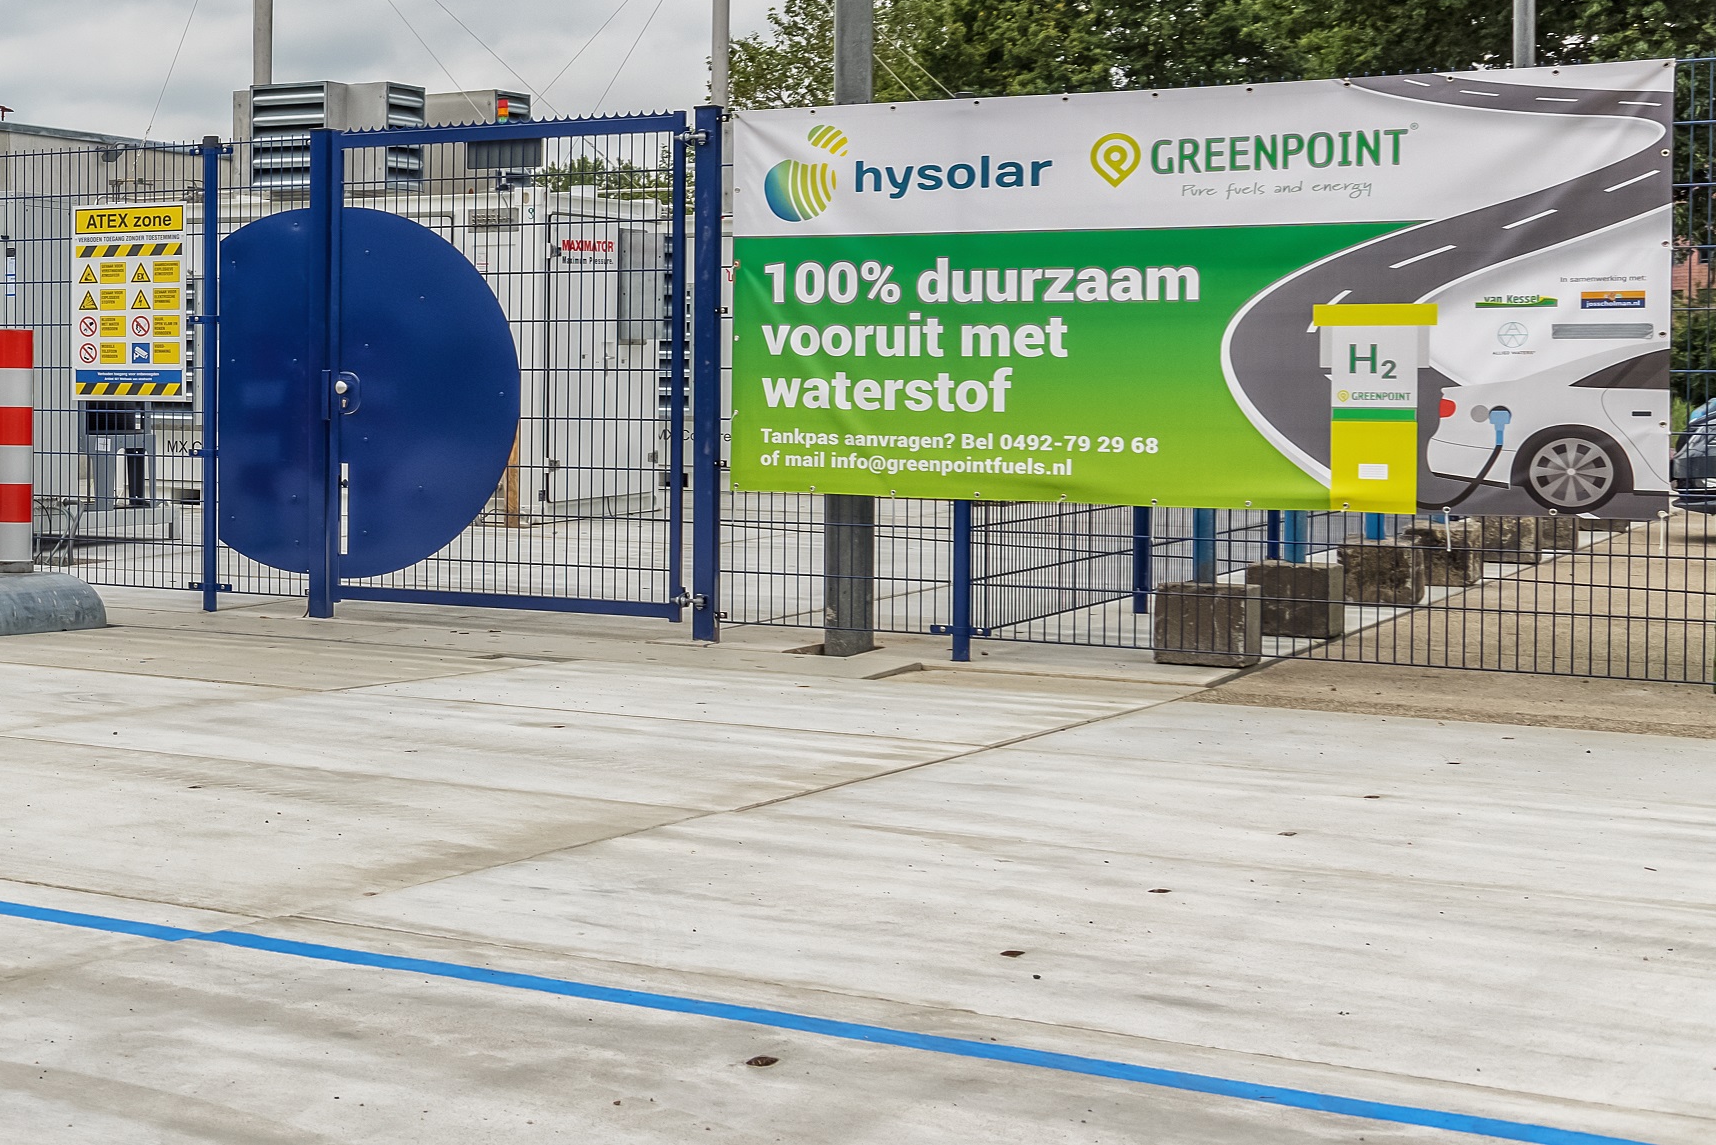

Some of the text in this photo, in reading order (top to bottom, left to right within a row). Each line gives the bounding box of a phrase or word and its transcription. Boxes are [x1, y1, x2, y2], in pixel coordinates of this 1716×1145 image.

[1151, 128, 1409, 175] GREENPOINT
[855, 155, 1053, 200] hysolar
[1181, 181, 1373, 200] Pure fuels and energy
[86, 213, 172, 229] ATEX zone
[562, 240, 614, 252] MAXIMATOR
[763, 257, 1201, 304] 100% duurzaam
[1506, 294, 1540, 304] Kessel
[761, 312, 1069, 358] vooruit met
[761, 366, 1013, 413] waterstof
[1351, 391, 1412, 401] GREENPOINT
[167, 440, 188, 453] MX
[760, 428, 1159, 454] Tankpas aanvragen? Bel 0492-79 29 68
[760, 450, 1073, 476] of mail info@greenpointfuels.nl
